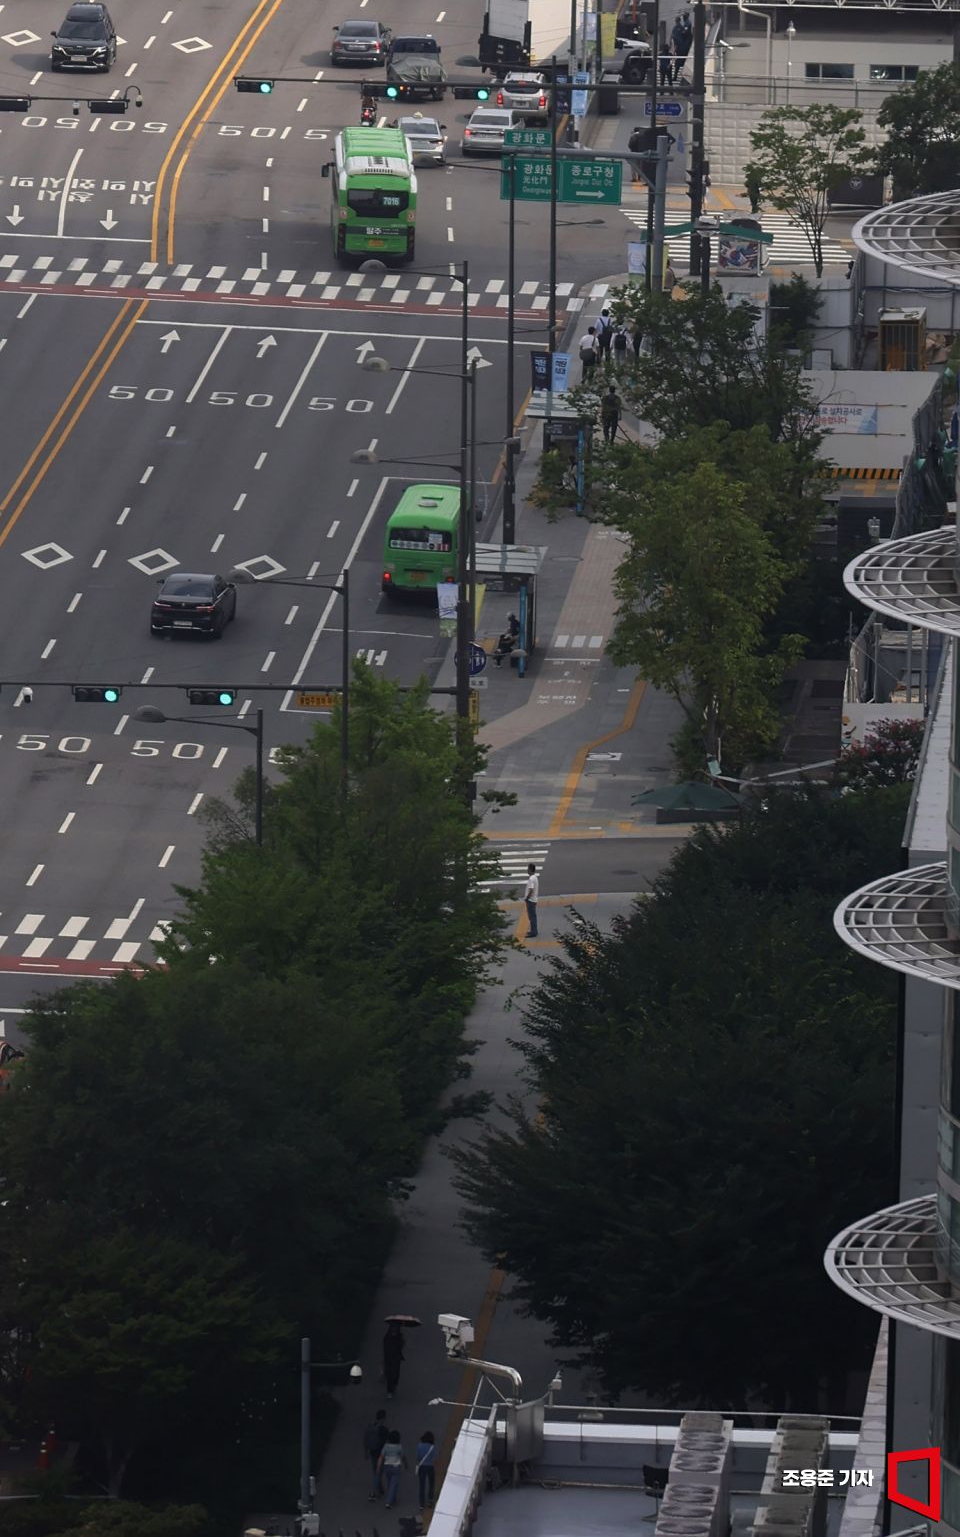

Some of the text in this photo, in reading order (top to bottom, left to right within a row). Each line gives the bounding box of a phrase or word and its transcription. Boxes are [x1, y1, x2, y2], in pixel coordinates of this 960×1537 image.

[21, 116, 80, 130] 50
[109, 119, 169, 133] 50
[217, 125, 277, 140] 50
[303, 128, 332, 140] 5
[512, 133, 545, 144] 광화문
[572, 166, 614, 176] 종로구청
[383, 197, 400, 206] 7016
[108, 385, 174, 402] 50
[208, 391, 274, 408] 50
[308, 397, 374, 413] 50
[15, 734, 92, 754] 50
[129, 740, 204, 760] 50
